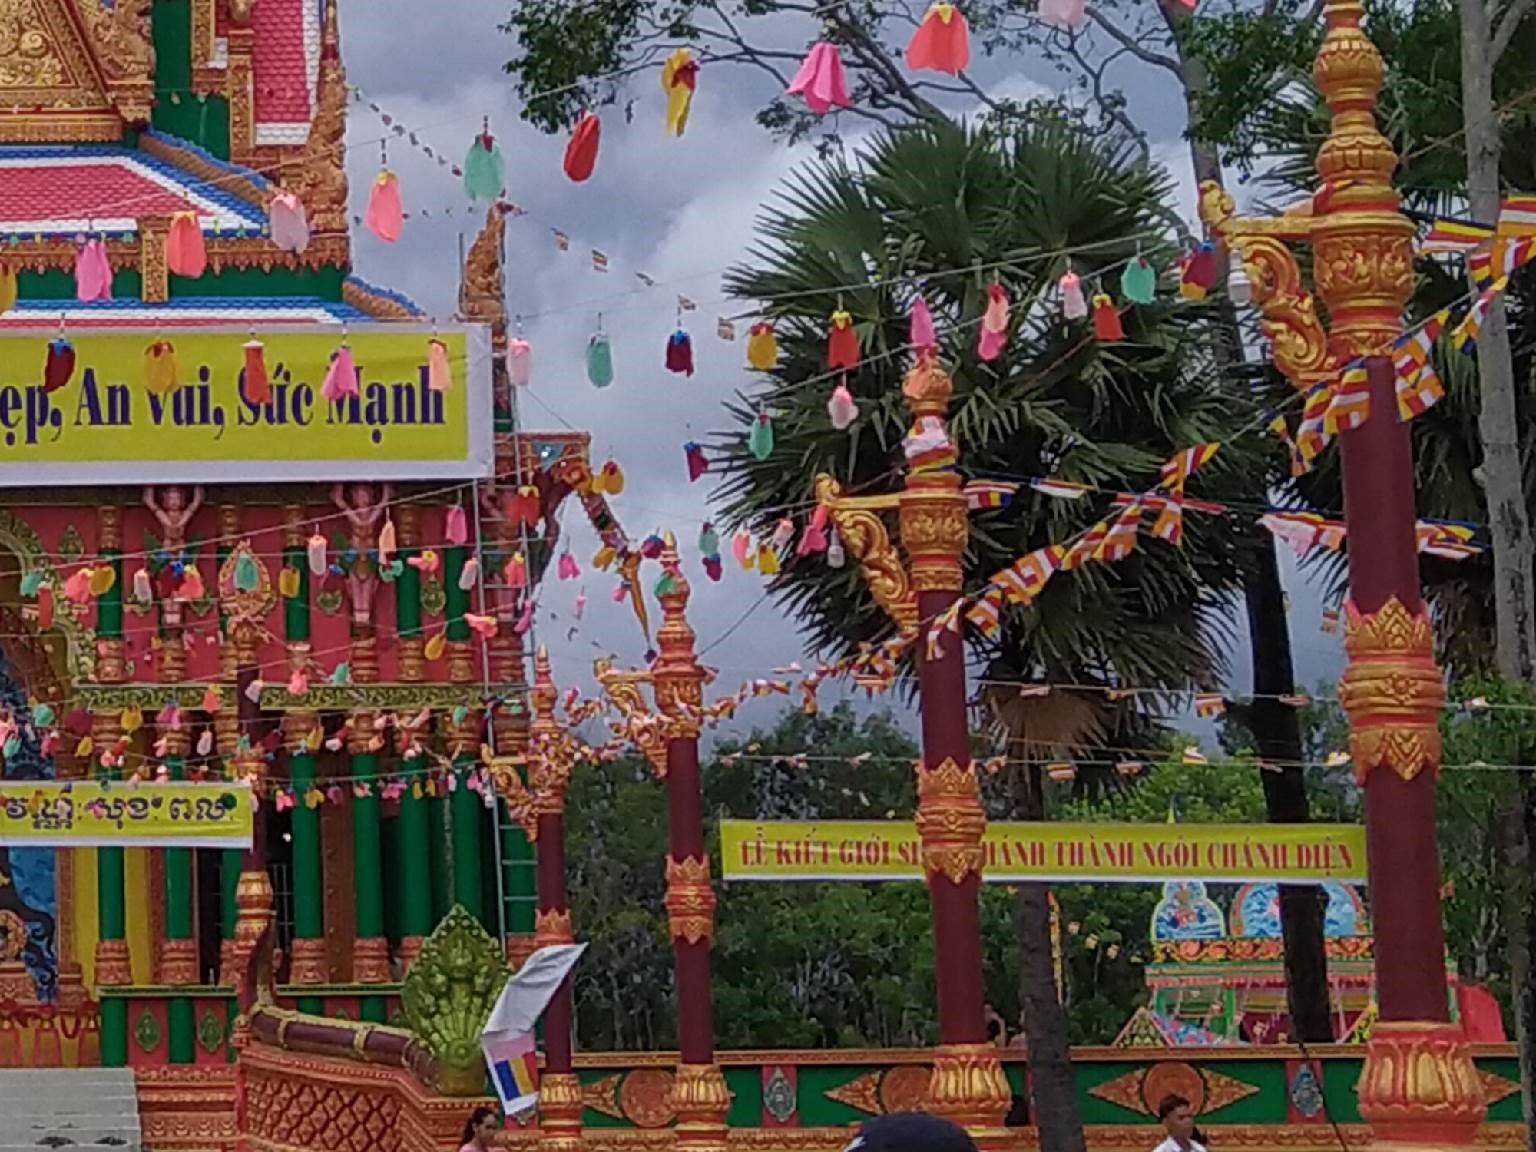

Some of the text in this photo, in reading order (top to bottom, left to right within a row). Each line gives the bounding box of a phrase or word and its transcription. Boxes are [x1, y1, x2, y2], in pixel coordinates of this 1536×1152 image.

[74, 367, 132, 426] An
[1054, 834, 1135, 867] THÀNH
[1142, 835, 1199, 868] NGÔI
[1206, 836, 1289, 869] CHÁNH
